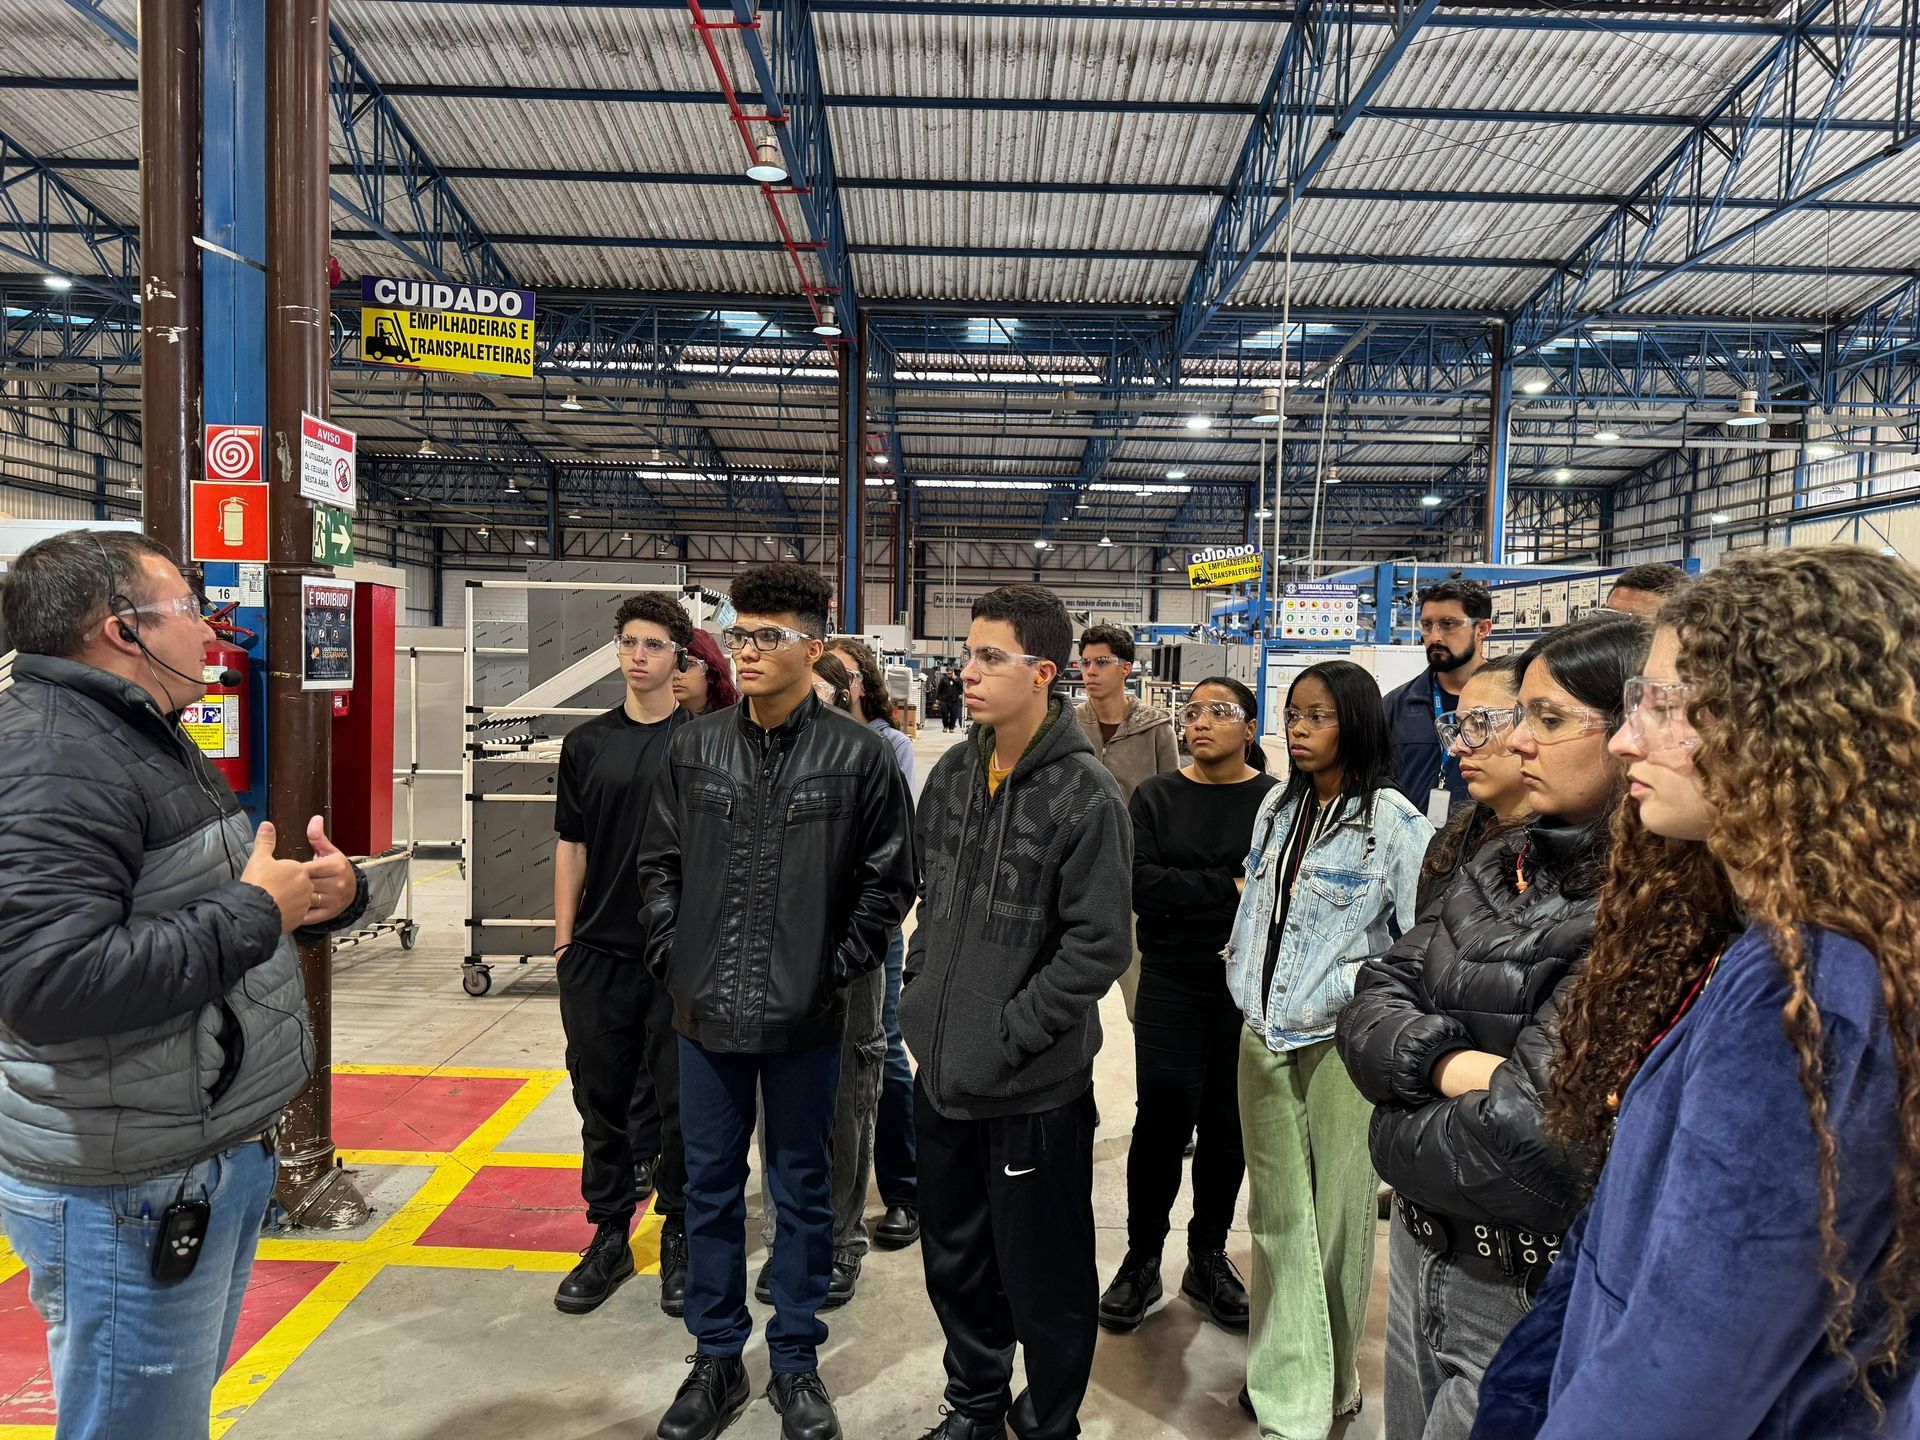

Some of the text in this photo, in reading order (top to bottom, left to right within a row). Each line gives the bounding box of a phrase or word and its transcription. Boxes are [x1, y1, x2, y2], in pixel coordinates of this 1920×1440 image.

[374, 279, 522, 316] CUIDADO
[409, 312, 529, 340] EMPILHADEIRAS E
[409, 337, 531, 365] TRANSPALETEIRAS
[317, 428, 341, 445] AVISO
[304, 438, 325, 452] PROIBIDA
[309, 452, 332, 466] UTILIZAÇÃO
[311, 464, 329, 476] CELULAR
[304, 474, 330, 488] NESTA ÁREA
[1191, 544, 1255, 564] CUIDADO
[1208, 556, 1254, 570] EMPILHADEIRAS
[1210, 565, 1262, 580] TRANSPALETEIRAS
[217, 588, 230, 599] 16
[1298, 583, 1325, 591] SEGURANÇA
[309, 589, 348, 607] É PROIBIDO
